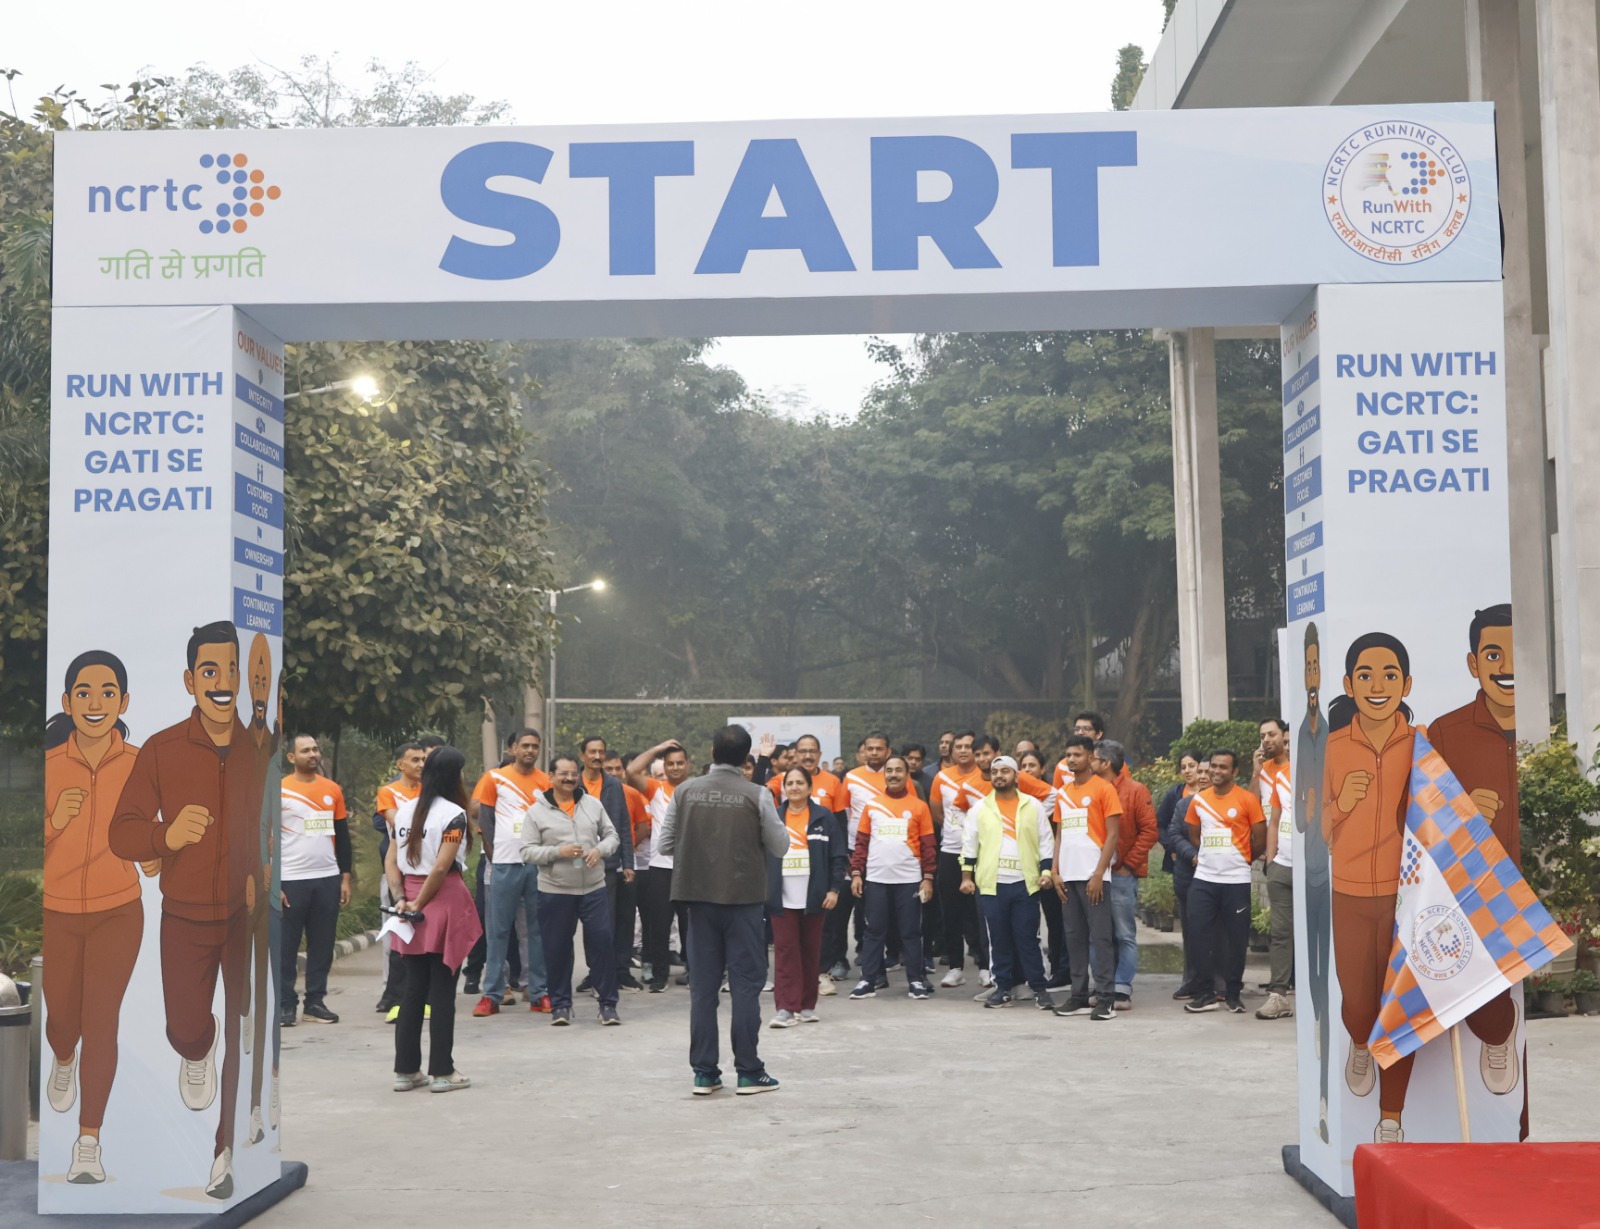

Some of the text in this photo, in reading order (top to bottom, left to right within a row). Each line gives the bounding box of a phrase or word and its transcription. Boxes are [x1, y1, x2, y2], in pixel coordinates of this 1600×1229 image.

[1327, 124, 1466, 186] NCRTC RUNNING CLUB
[88, 179, 203, 213] ncrtc
[439, 131, 1138, 280] START
[1363, 199, 1432, 213] RunWith
[1332, 210, 1465, 261] एनसीआरटीसी रनिंग क्लब
[1372, 220, 1425, 234] NCRTC
[98, 247, 267, 280] गति से प्रगति
[238, 330, 283, 376] OUR VALUES
[1337, 351, 1496, 378] RUN WITH
[67, 372, 223, 398] RUN WITH
[248, 387, 273, 412] INTEGRITY
[1357, 390, 1478, 416] NCRTC:
[85, 411, 203, 435] NCRTC:
[1287, 414, 1317, 445] COLLABORATION
[240, 432, 280, 462] COLLABORATION
[1357, 429, 1478, 455] GATI SE
[85, 449, 202, 474] GATI SE
[1293, 466, 1312, 488] CUSTOMER
[1348, 468, 1489, 493] PRAGATI
[74, 486, 212, 512] PRAGATI
[246, 483, 273, 504] CUSTOMER
[1296, 485, 1309, 503] FOCUS
[251, 502, 268, 519] FOCUS
[1293, 531, 1315, 552] OWNERSHIP
[244, 547, 274, 567] OWNERSHIP
[1293, 580, 1317, 599] CONTINUOUS
[243, 595, 275, 615] CONTINUOUS
[1296, 599, 1315, 616] LEARNING
[246, 614, 271, 630] LEARNING
[722, 794, 745, 804] GEAR
[1419, 940, 1435, 965] NCRTC
